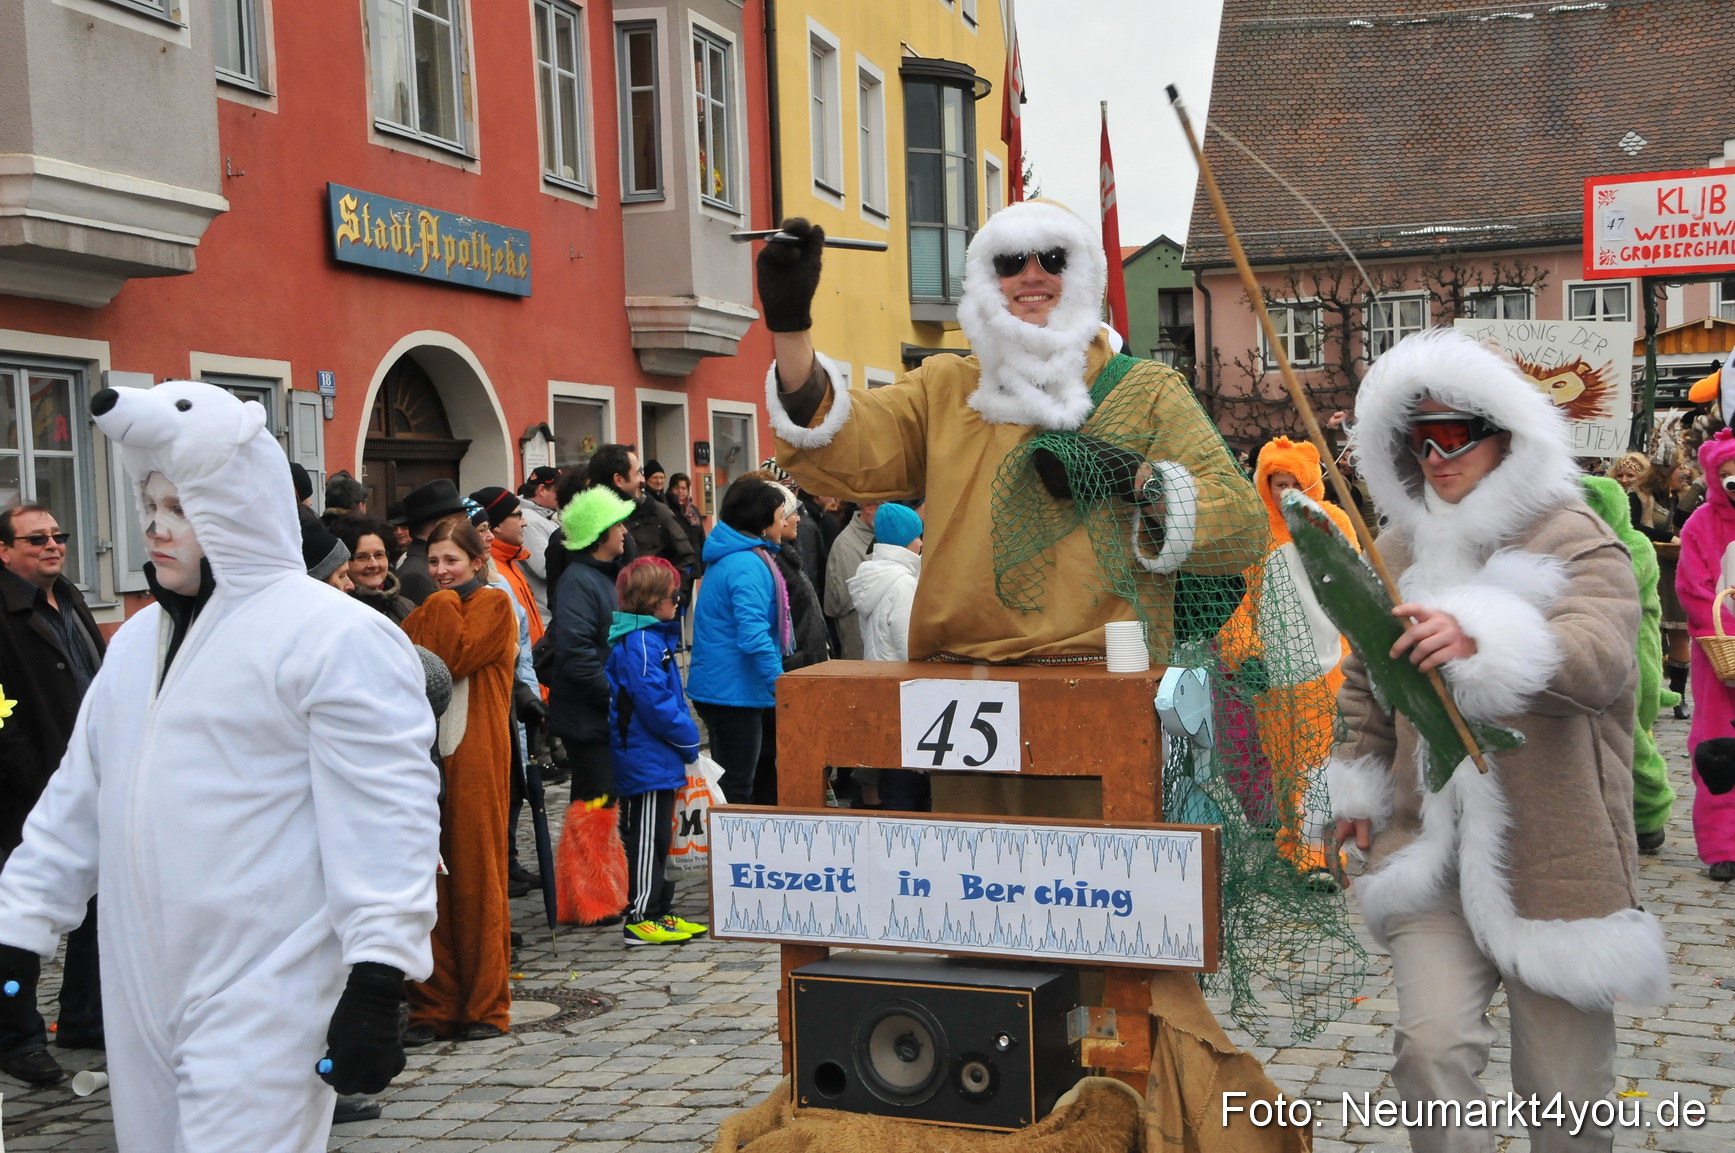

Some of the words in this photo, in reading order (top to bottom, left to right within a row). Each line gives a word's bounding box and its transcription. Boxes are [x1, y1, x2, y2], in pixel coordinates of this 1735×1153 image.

[1606, 217, 1625, 230] 47
[1503, 322, 1560, 343] KÖNIG
[1569, 325, 1608, 355] DER
[321, 373, 332, 386] 18
[916, 699, 1004, 767] 45
[679, 808, 704, 837] M
[728, 863, 857, 893] Eiszeit
[897, 870, 931, 897] in
